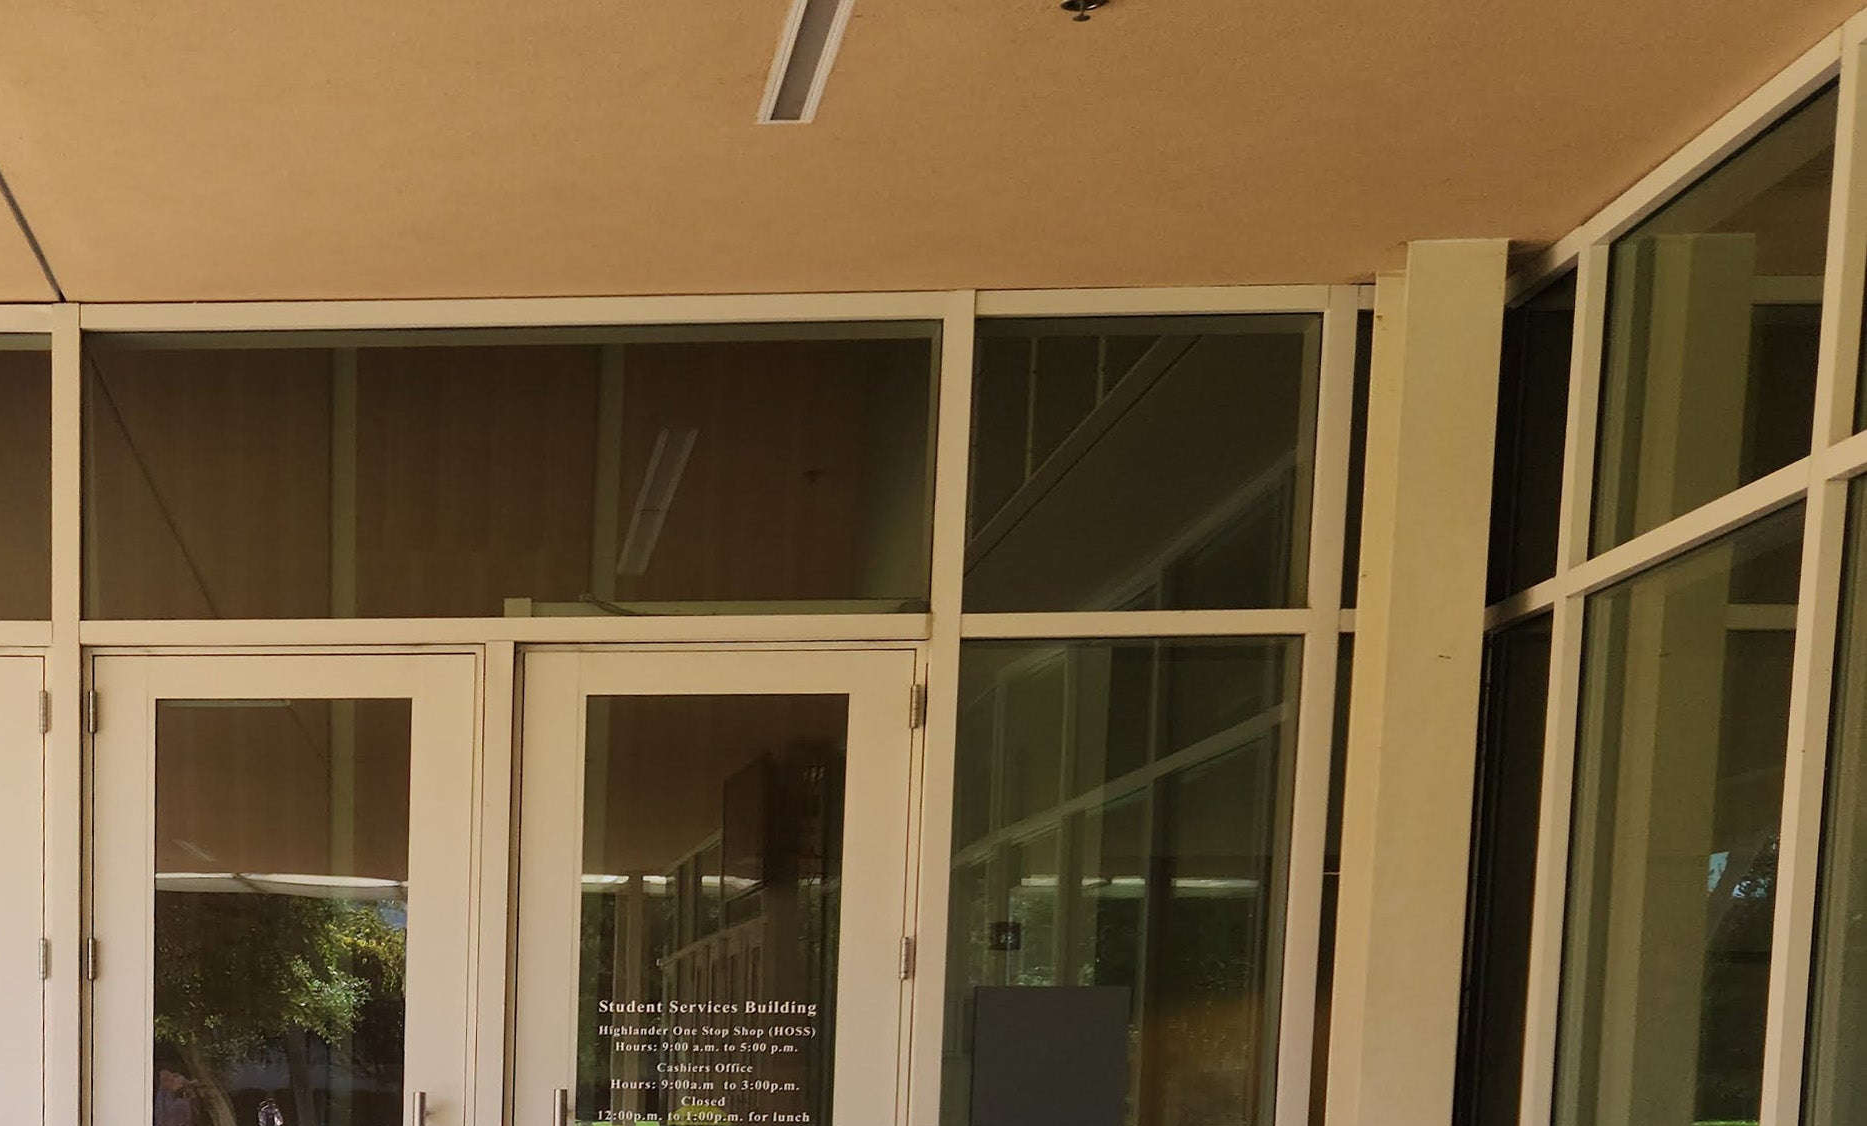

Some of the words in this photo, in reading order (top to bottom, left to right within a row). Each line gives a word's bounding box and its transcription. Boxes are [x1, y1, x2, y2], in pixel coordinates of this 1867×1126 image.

[598, 999, 663, 1013] Student
[669, 1000, 738, 1013] Services
[745, 1000, 817, 1017] Building
[598, 1025, 669, 1037] Highlander
[673, 1025, 698, 1036] One
[701, 1025, 729, 1038] Stop
[733, 1026, 764, 1038] Shop
[768, 1026, 816, 1039] (HOSS)
[615, 1041, 658, 1052] Hours:
[662, 1042, 689, 1052] 9:00
[692, 1044, 719, 1052] a.m.
[723, 1043, 736, 1052] to
[740, 1042, 767, 1052] 5:00
[770, 1044, 798, 1054] p.m.
[656, 1062, 710, 1073] Cashiers
[715, 1063, 753, 1073] Office
[610, 1079, 656, 1089] Hours:
[723, 1080, 737, 1090] to
[741, 1080, 800, 1093] 3:00p.m.
[681, 1096, 726, 1107] Closed
[598, 1110, 662, 1123] 12:00p.m.
[668, 1111, 680, 1121] to
[686, 1111, 743, 1124] 1:00p.m.
[749, 1112, 769, 1122] for
[773, 1112, 810, 1122] lunch
